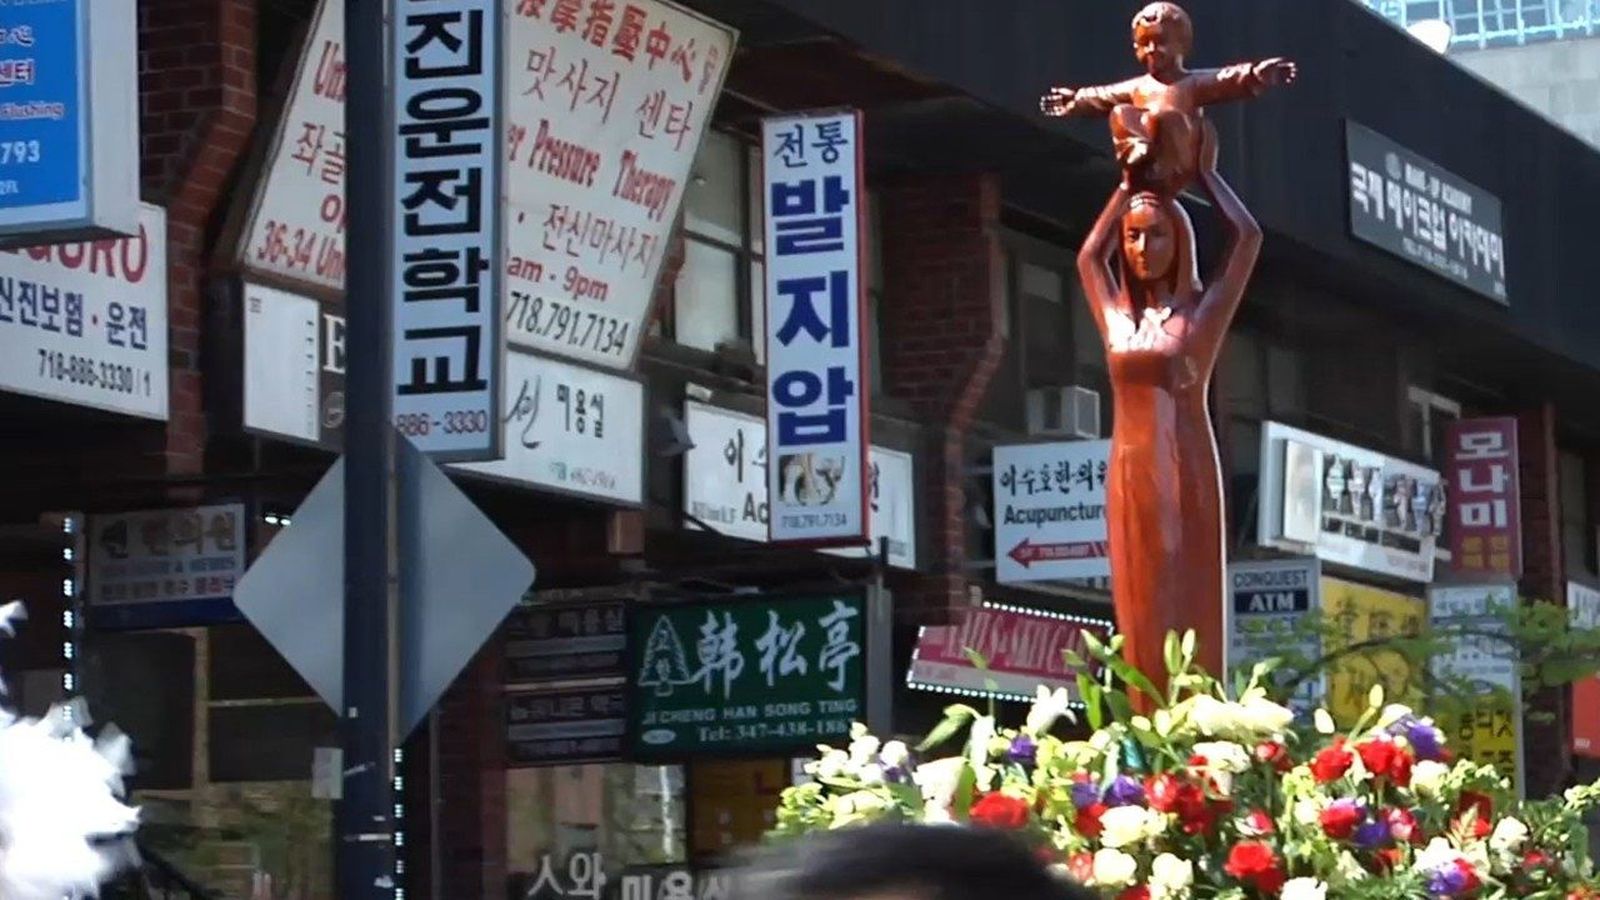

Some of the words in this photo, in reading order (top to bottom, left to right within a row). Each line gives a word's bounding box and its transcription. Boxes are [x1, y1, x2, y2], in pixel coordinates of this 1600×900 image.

[635, 90, 693, 151] 센타
[773, 119, 849, 169] 전통
[527, 118, 601, 188] Pressure
[612, 149, 677, 222] Therapy
[398, 0, 489, 395] 진운전학교
[562, 265, 609, 302] 9pm
[105, 301, 148, 351] 운전
[506, 290, 630, 357] 718.791.7134
[770, 174, 854, 448] 발지압
[556, 383, 605, 438] 미용실
[1456, 431, 1509, 528] 모나미
[1003, 502, 1107, 528] Acupunctur
[1233, 569, 1308, 588] CONQUEST
[1248, 592, 1295, 612] ATM
[723, 704, 759, 720] HAN
[764, 701, 812, 717] SONG
[817, 698, 860, 715] TING
